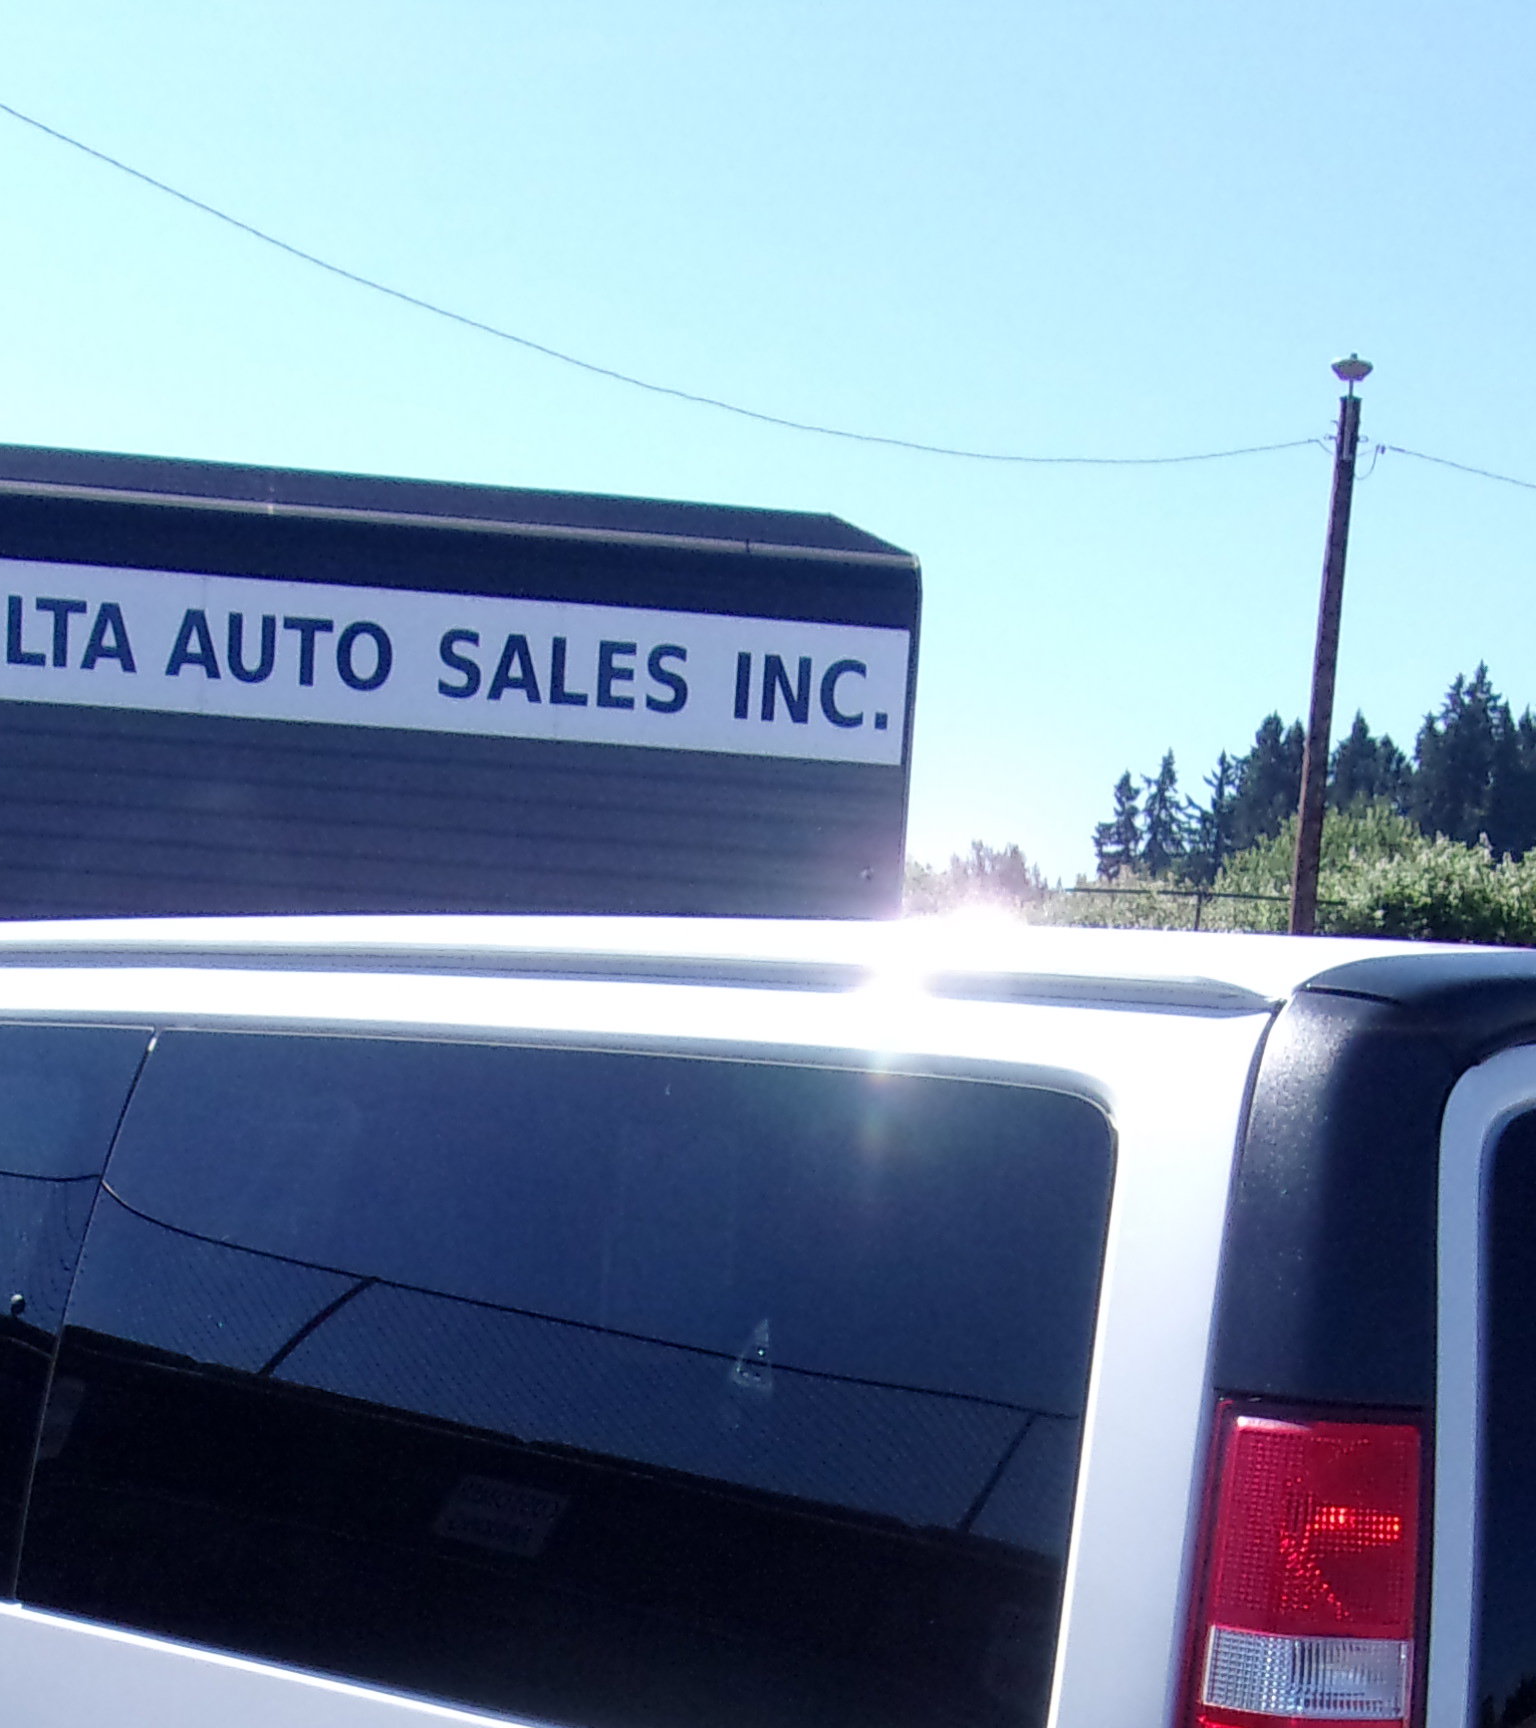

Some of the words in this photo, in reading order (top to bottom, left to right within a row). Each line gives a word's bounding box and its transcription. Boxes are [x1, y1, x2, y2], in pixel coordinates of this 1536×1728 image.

[164, 608, 394, 692] AUTO
[436, 629, 690, 715] SALES
[732, 651, 889, 731] INC.
